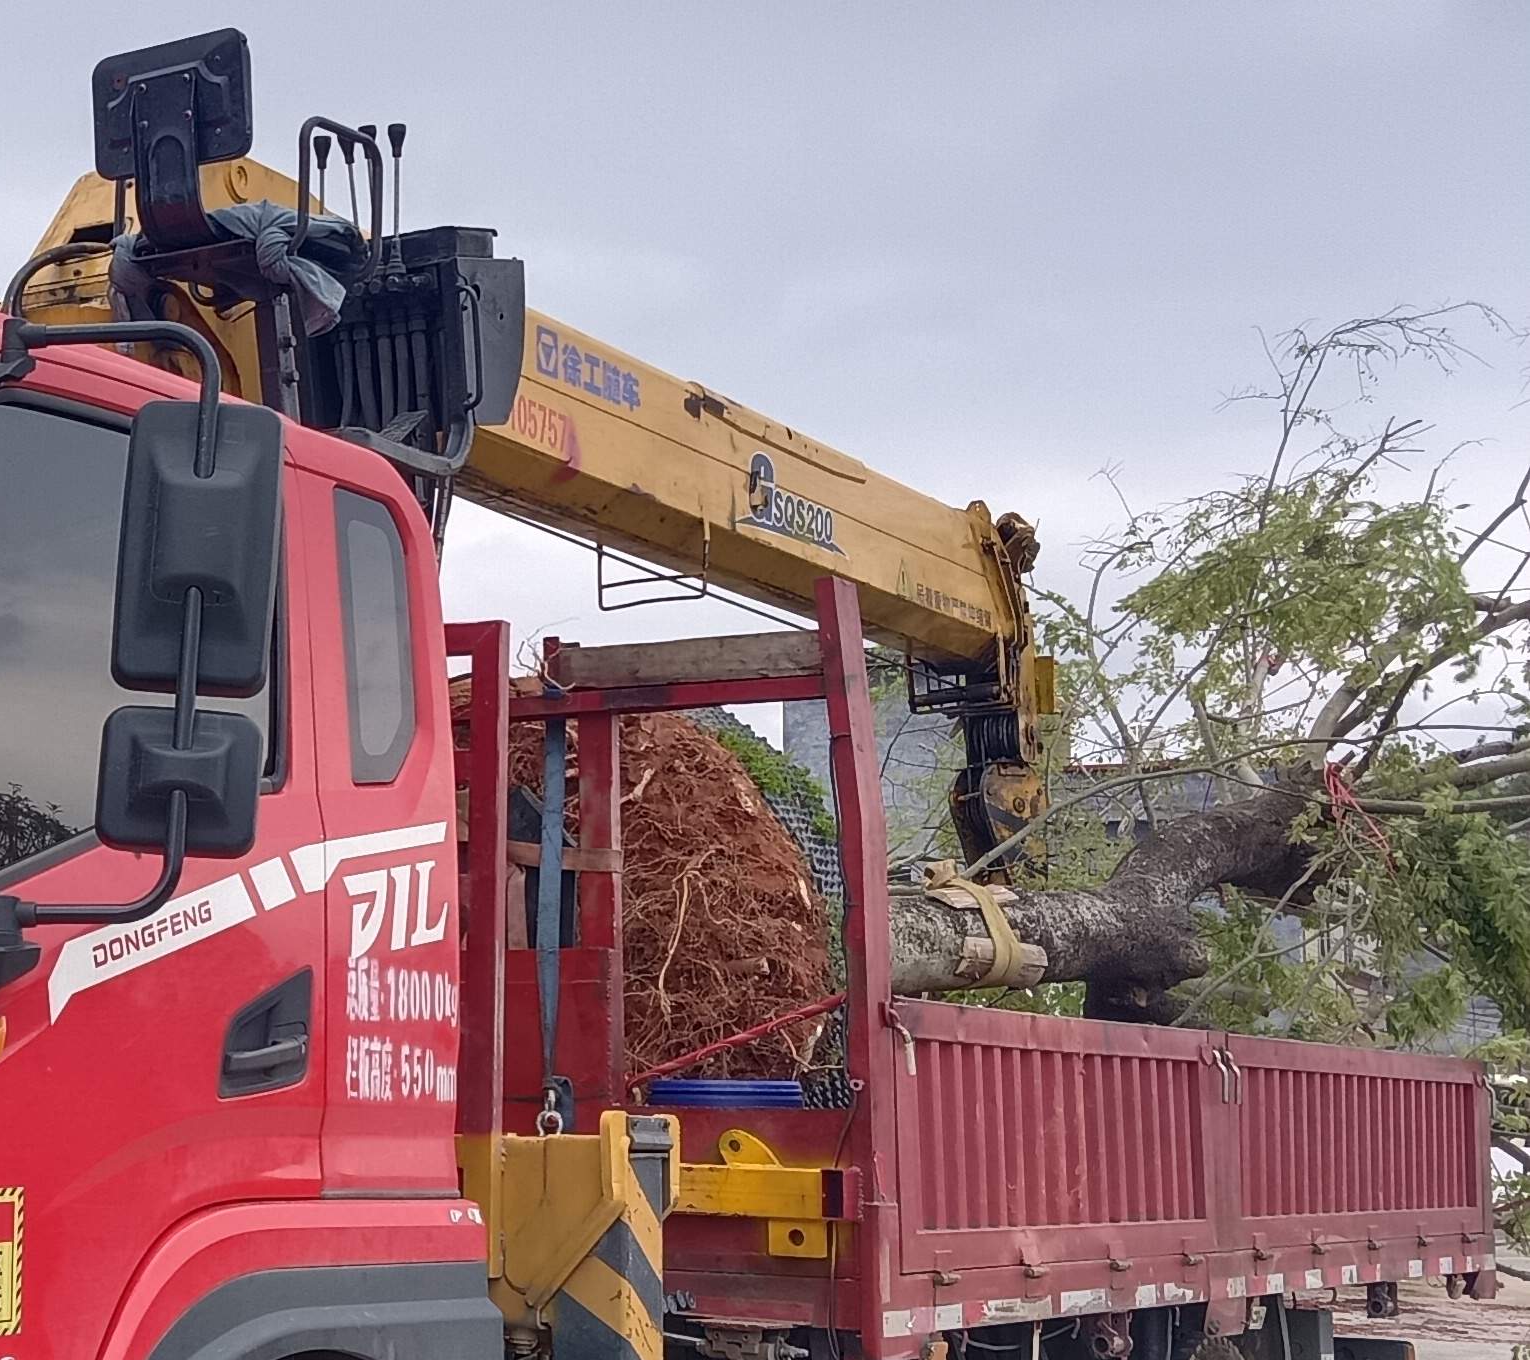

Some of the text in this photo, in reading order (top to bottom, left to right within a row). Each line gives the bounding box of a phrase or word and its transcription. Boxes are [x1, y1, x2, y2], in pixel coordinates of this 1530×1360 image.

[562, 343, 641, 412] 徐工随车
[92, 900, 212, 968] DONGFENG
